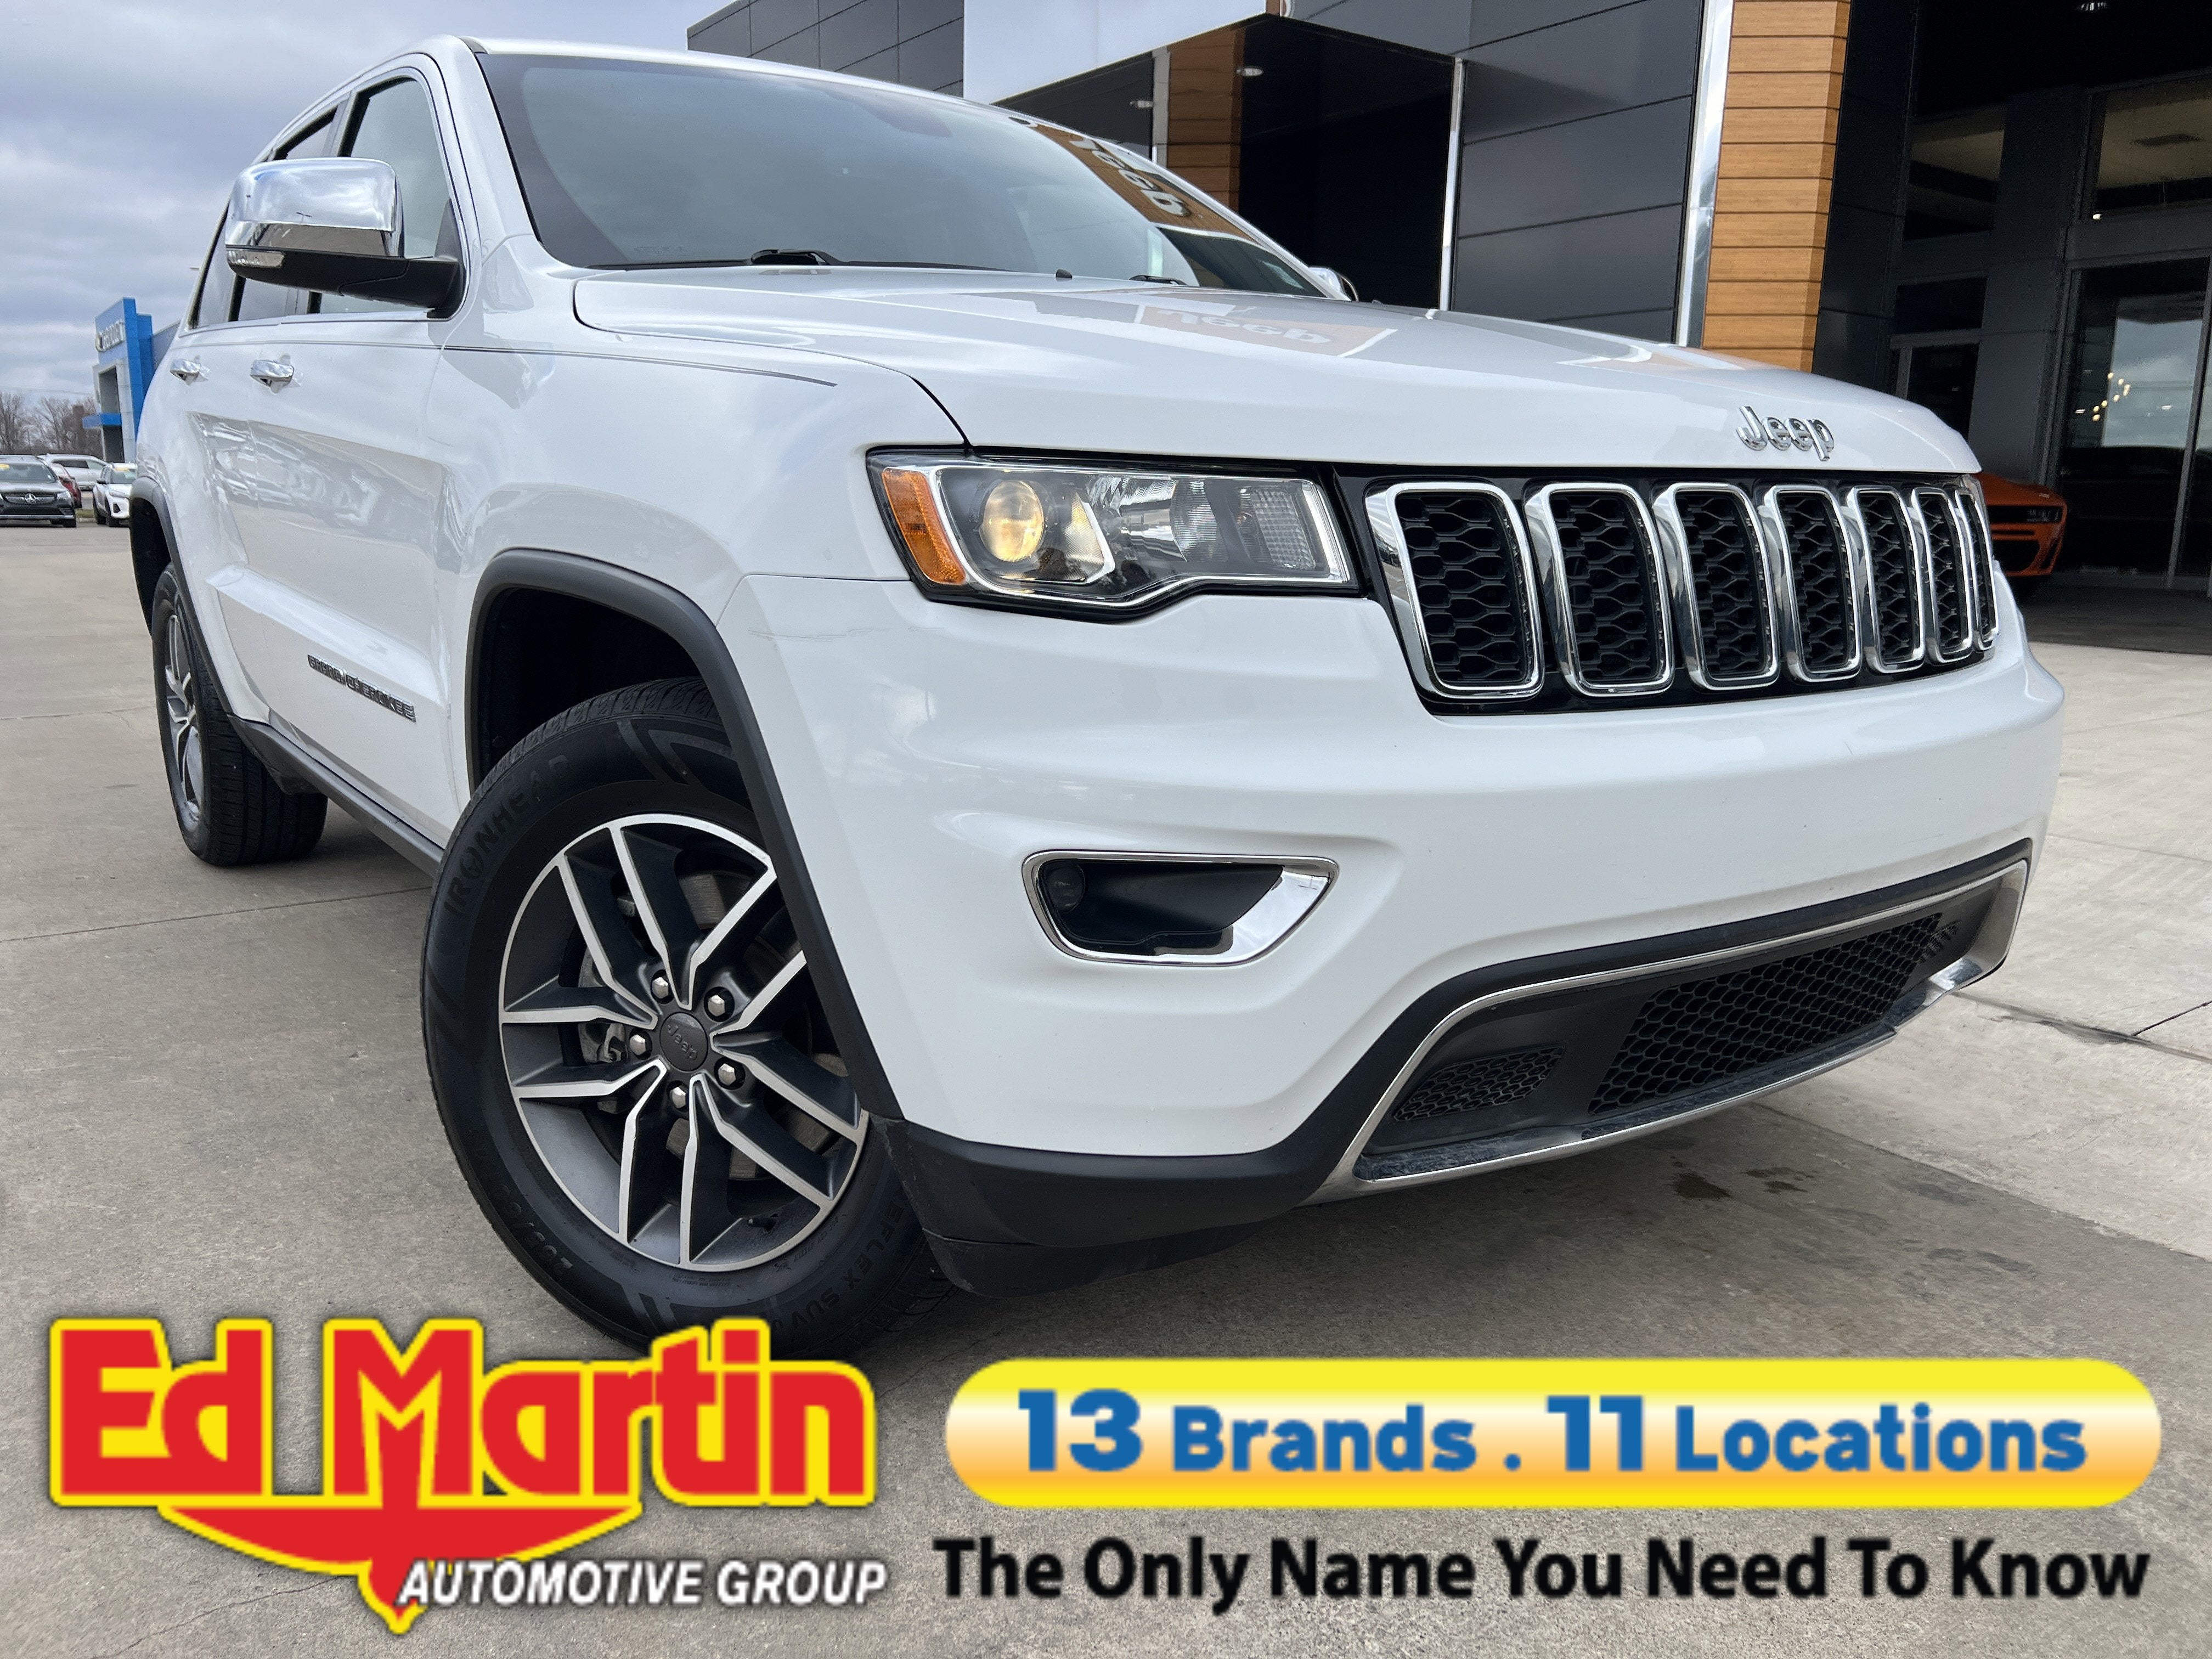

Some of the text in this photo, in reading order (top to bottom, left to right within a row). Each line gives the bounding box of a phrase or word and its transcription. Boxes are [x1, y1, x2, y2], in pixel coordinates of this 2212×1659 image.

[1736, 406, 1835, 461] Jeep
[307, 654, 417, 724] GRAND CHEROKEE
[668, 1025, 698, 1061] Jeep
